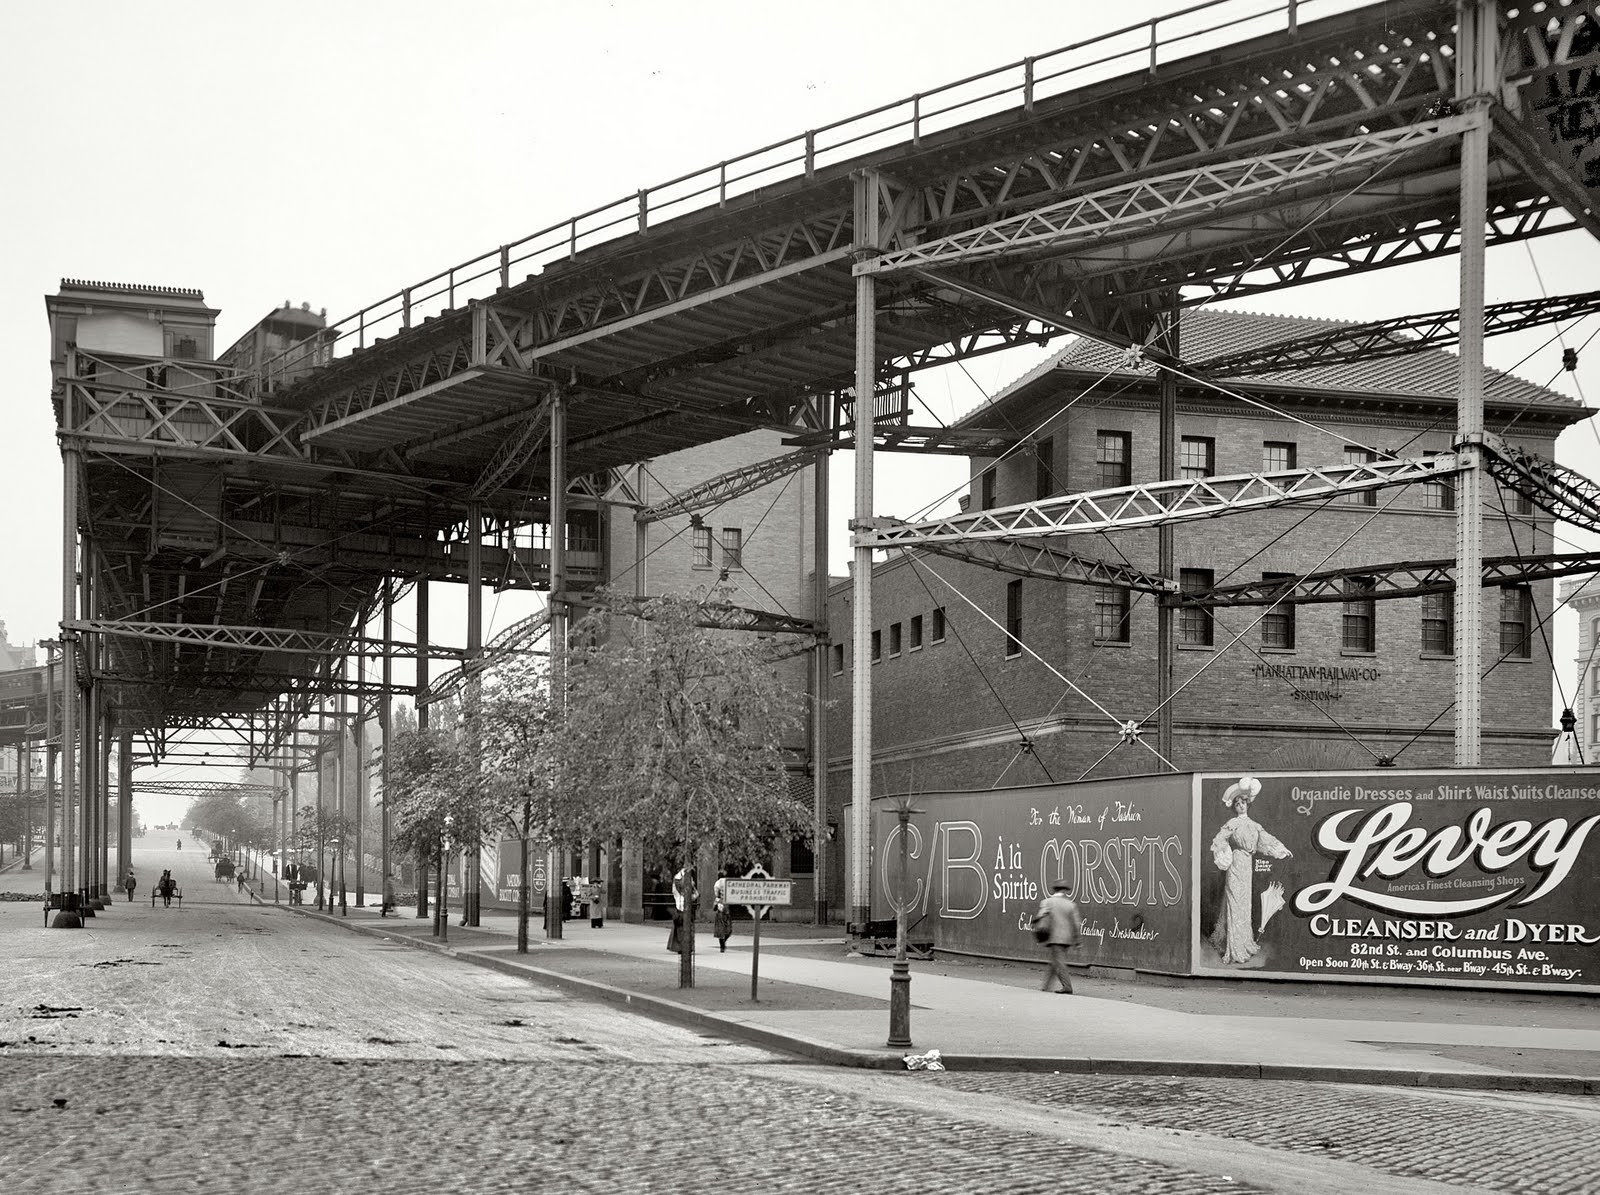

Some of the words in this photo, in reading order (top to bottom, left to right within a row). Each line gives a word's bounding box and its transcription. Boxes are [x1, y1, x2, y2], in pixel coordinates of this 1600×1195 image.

[1029, 807, 1043, 826] For
[1048, 806, 1061, 826] the
[1066, 804, 1092, 824] Woman
[1098, 806, 1109, 831] of
[1111, 800, 1142, 823] Fashion
[1292, 786, 1351, 816] Organdie
[1355, 786, 1412, 800] Dresses
[1416, 790, 1433, 800] and
[1438, 785, 1472, 800] Shirt
[1475, 785, 1509, 800] Waist
[1512, 785, 1543, 800] Suits
[1041, 835, 1183, 907] CORSETS
[1296, 802, 1600, 912] Levey
[993, 873, 1038, 913] Spirite
[1387, 881, 1425, 892] America's
[1427, 880, 1451, 890] Finest
[1454, 878, 1495, 892] Cleansing
[1496, 876, 1525, 887] Shops
[1109, 917, 1159, 941] Dressmakers
[1310, 913, 1463, 940] CLEANSER
[1465, 924, 1500, 941] and
[1504, 919, 1600, 944] DYER
[1300, 956, 1324, 970] Open
[1326, 957, 1348, 968] Soon
[1351, 958, 1369, 970] 20th
[1417, 960, 1435, 973] 36th
[1492, 962, 1514, 976] 45th
[1516, 963, 1531, 975] St.
[1532, 966, 1541, 976] &
[1350, 943, 1383, 955] 82nd
[1386, 944, 1402, 956] St.
[1406, 948, 1428, 957] and
[1431, 945, 1512, 960] Columbus
[1517, 948, 1549, 961] Ave.
